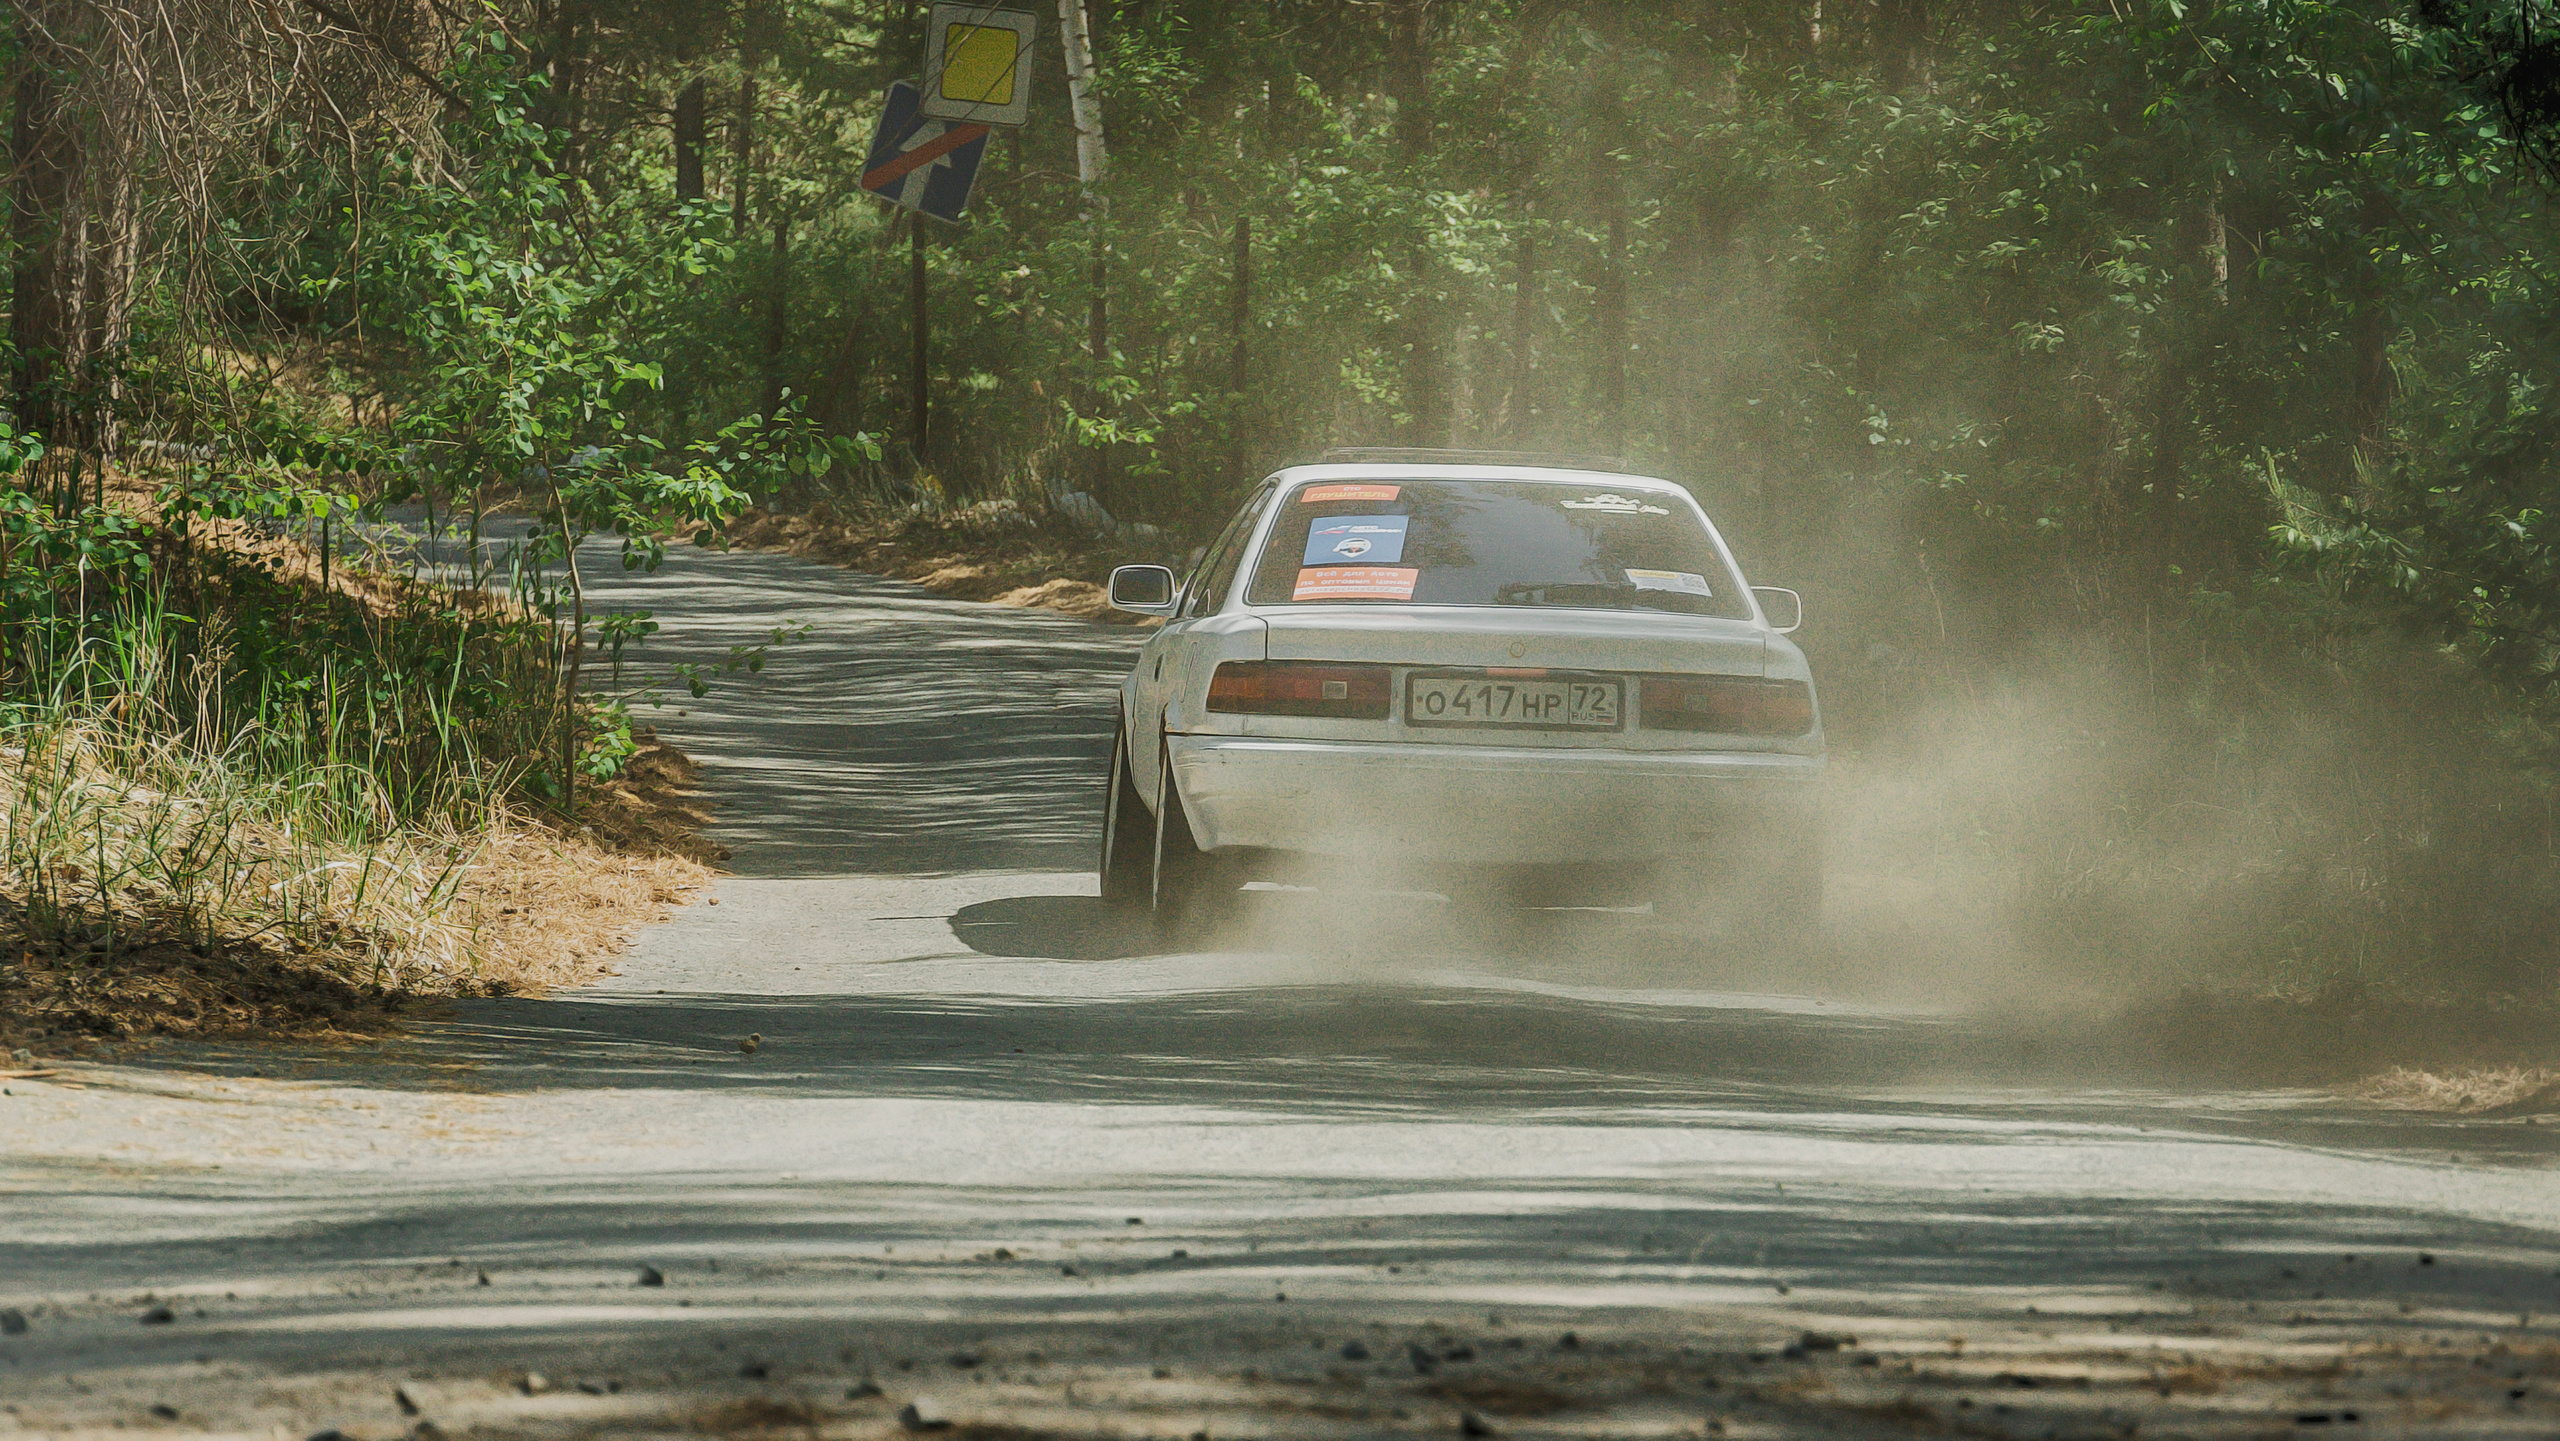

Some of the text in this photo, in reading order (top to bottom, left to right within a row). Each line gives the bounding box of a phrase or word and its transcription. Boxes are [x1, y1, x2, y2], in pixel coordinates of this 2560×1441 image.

[1310, 491, 1390, 499] ГЛУШИТЕЛЬ
[1574, 685, 1607, 712] 72
[1571, 711, 1596, 722] RUS
